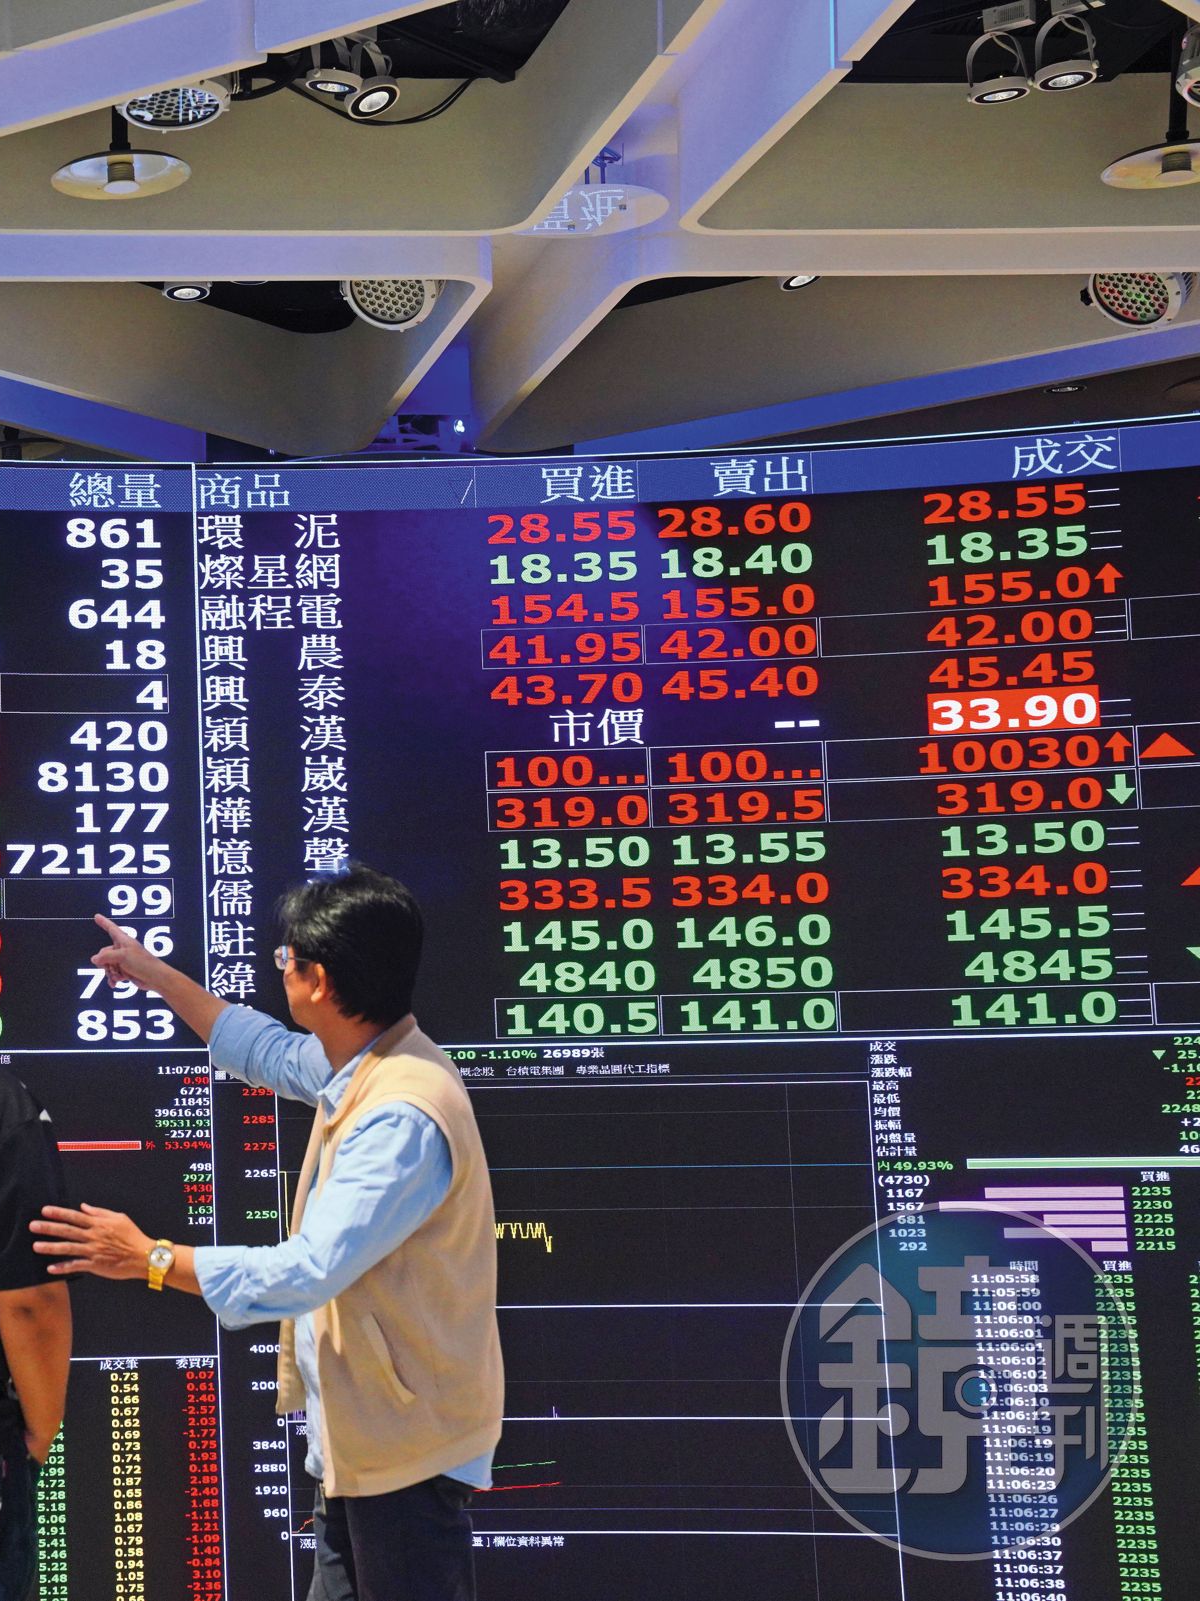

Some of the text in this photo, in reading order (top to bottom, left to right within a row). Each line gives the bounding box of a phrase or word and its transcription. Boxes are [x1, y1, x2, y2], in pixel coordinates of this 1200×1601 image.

[198, 433, 1118, 511] 商品 買進 賣出 成交
[69, 472, 162, 509] 總量
[197, 484, 1087, 551] 環 泥 28.55 28.60 28.55
[65, 518, 163, 550] 861
[198, 526, 1088, 591] 燦星網 18.35 18.40 18.35
[101, 559, 165, 591] 35
[200, 566, 1091, 632] 融程電 154.5 155.0 155.0
[68, 599, 167, 631] 644
[488, 609, 1094, 666] 41.95 42.00 42.00
[927, 651, 1096, 690] 45.45
[550, 692, 1098, 747] 市價 33.90
[69, 721, 169, 753] 420
[918, 736, 1101, 776] 10030
[37, 762, 171, 794] 8130
[75, 803, 171, 834] 177
[496, 789, 825, 829] 319.0 319.5
[6, 844, 171, 875] 72125
[500, 832, 827, 871] 13.50 13.55
[107, 885, 172, 916] 99
[500, 877, 651, 912] 333.5
[503, 914, 832, 953] 145.0 146.0
[519, 949, 1114, 994] 4840 4845
[76, 1009, 176, 1043] 853
[506, 999, 837, 1036] 140.5 141.0
[481, 1049, 537, 1060] -1.10%
[869, 1040, 897, 1051] 成交
[157, 1065, 210, 1075] 11:07:00
[180, 1087, 210, 1096] 6724
[154, 1108, 211, 1117] 39616.63
[243, 1115, 275, 1125] 2285
[165, 1130, 211, 1139] -257.01
[189, 1162, 212, 1172] 498
[244, 1169, 277, 1178] 2265
[877, 1173, 930, 1187] (4730)
[893, 1161, 953, 1172] 49.93%
[886, 1188, 924, 1198] 1167
[1131, 1186, 1171, 1197] 2235
[246, 1210, 278, 1219] 2250
[1135, 1240, 1176, 1252] 2215
[110, 1372, 139, 1382] 0.73
[252, 1440, 286, 1450] 3840
[254, 1463, 287, 1473] 2880
[992, 1550, 1159, 1565] 11:06:37 2235
[994, 1578, 1066, 1590] 11:06:38
